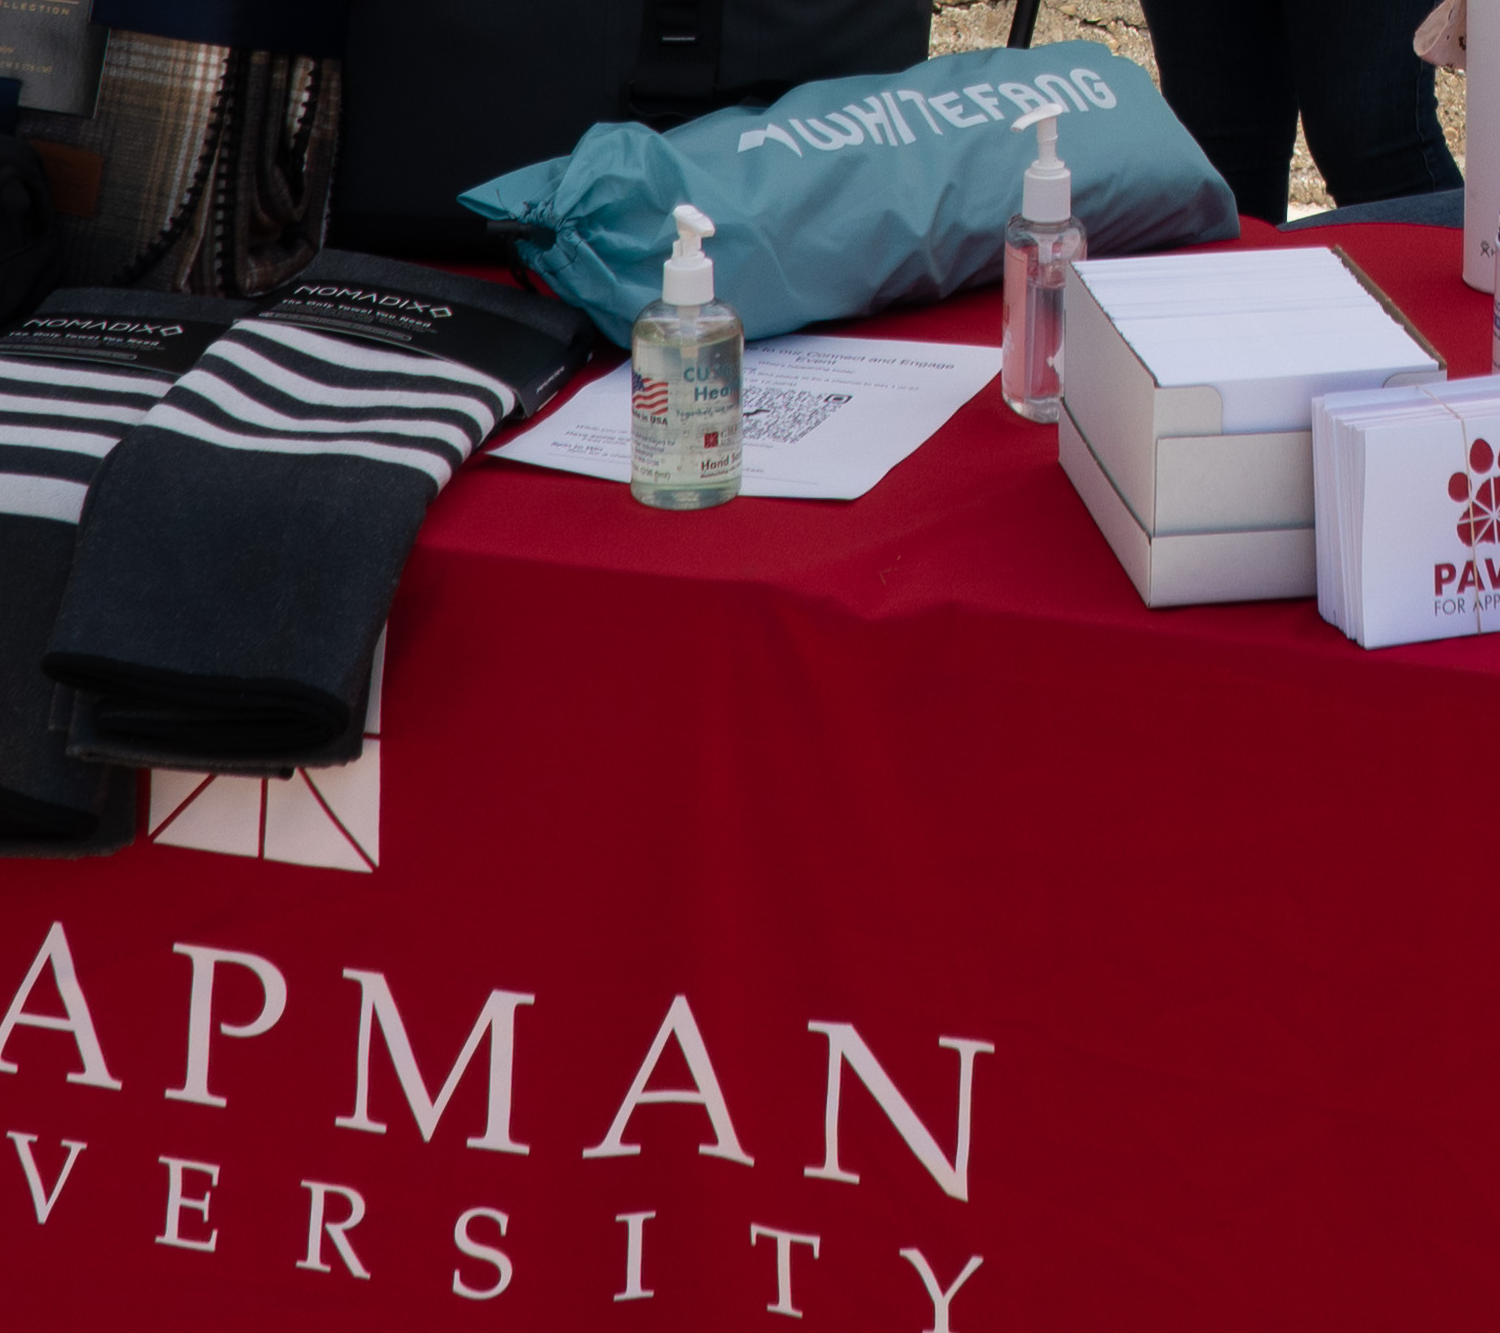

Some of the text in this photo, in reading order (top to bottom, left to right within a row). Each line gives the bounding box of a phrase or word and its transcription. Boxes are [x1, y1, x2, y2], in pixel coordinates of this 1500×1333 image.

[789, 68, 1117, 152] WHITEFANG
[293, 284, 433, 313] NOMADIX
[22, 318, 162, 334] NOMADIX
[807, 350, 865, 362] Connect
[900, 358, 955, 371] Engage
[700, 454, 730, 471] Hand
[1433, 597, 1467, 616] FOR
